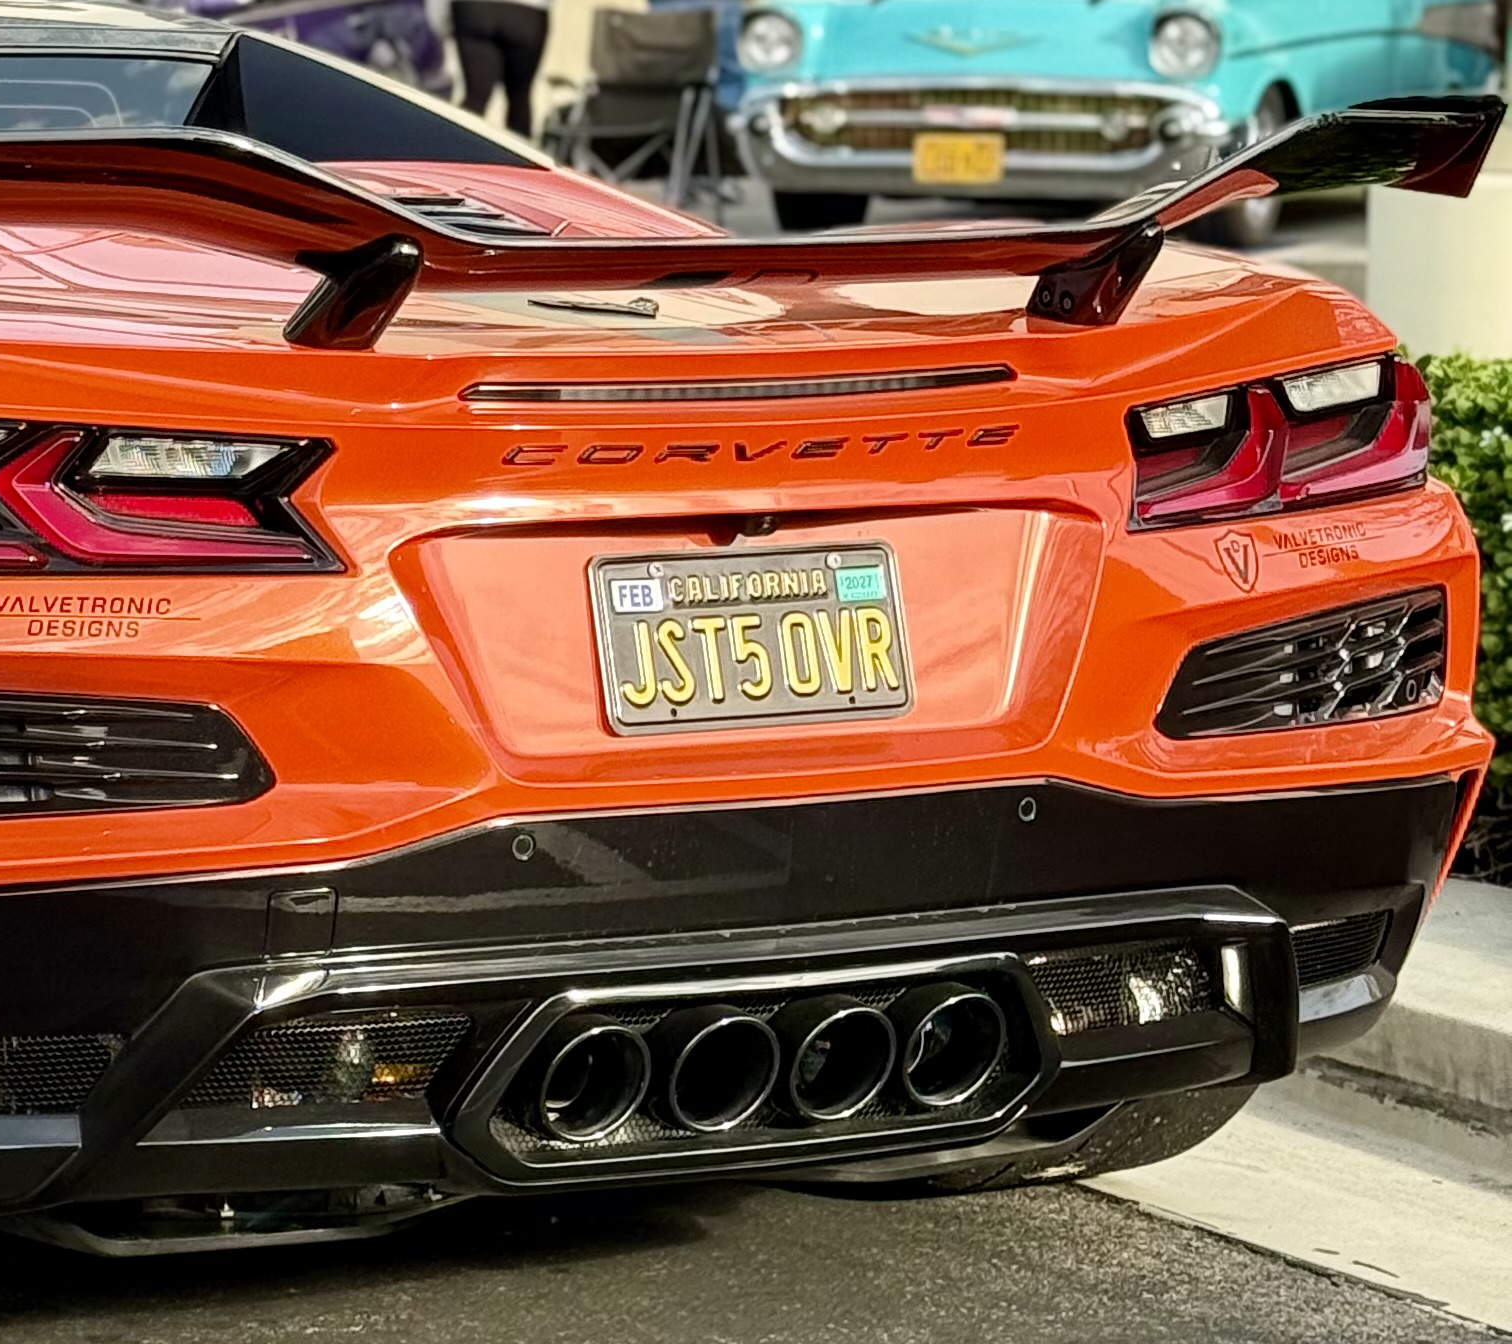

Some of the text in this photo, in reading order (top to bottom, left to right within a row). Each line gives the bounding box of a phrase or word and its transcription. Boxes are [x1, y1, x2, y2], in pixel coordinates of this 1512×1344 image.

[501, 424, 1020, 466] CORVETTE
[1273, 522, 1368, 549] VALVETRONIC
[1299, 545, 1360, 568] DESIGNS
[617, 569, 873, 607] FEB CALIFORNIA 2027
[27, 619, 140, 638] DESIGNS
